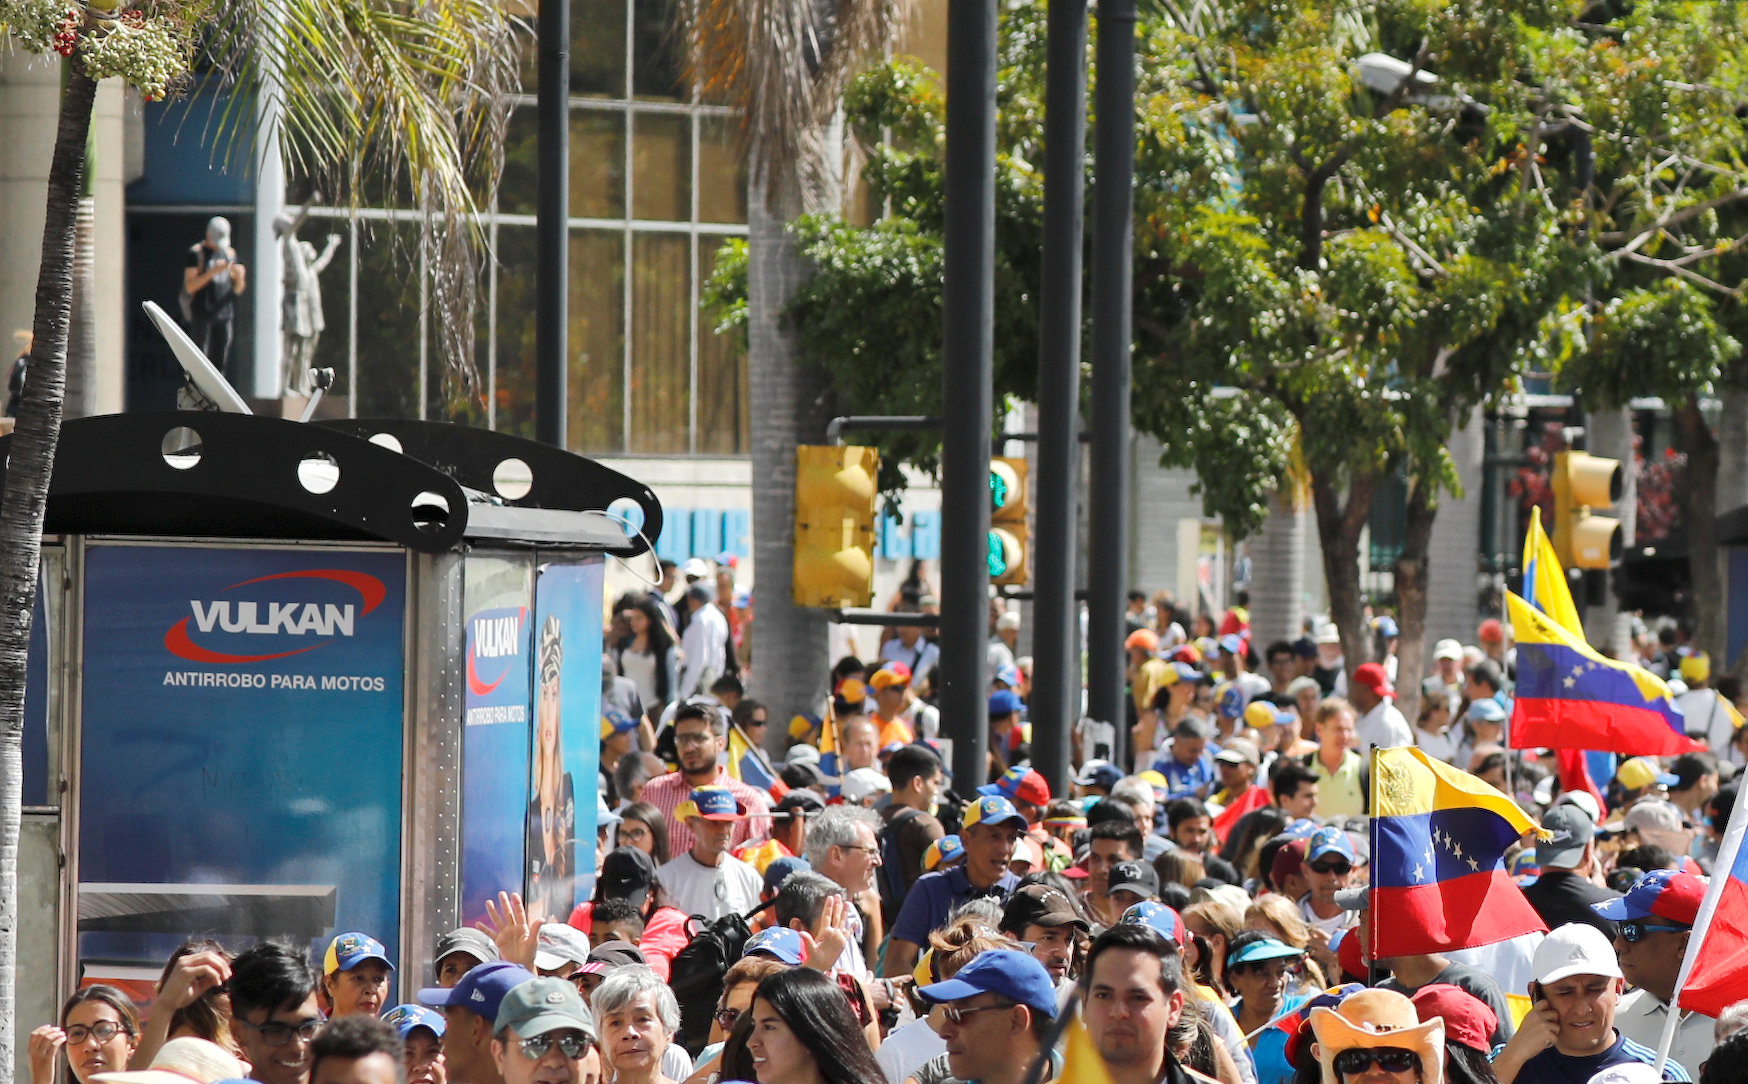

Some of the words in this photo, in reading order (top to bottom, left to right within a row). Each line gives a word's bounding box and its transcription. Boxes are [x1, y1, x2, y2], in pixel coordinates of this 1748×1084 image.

[190, 600, 354, 637] VULKAN
[474, 616, 519, 658] VULKAN
[163, 671, 266, 689] ANTIRROBO
[271, 674, 317, 690] PARA
[321, 676, 385, 692] MOTOS
